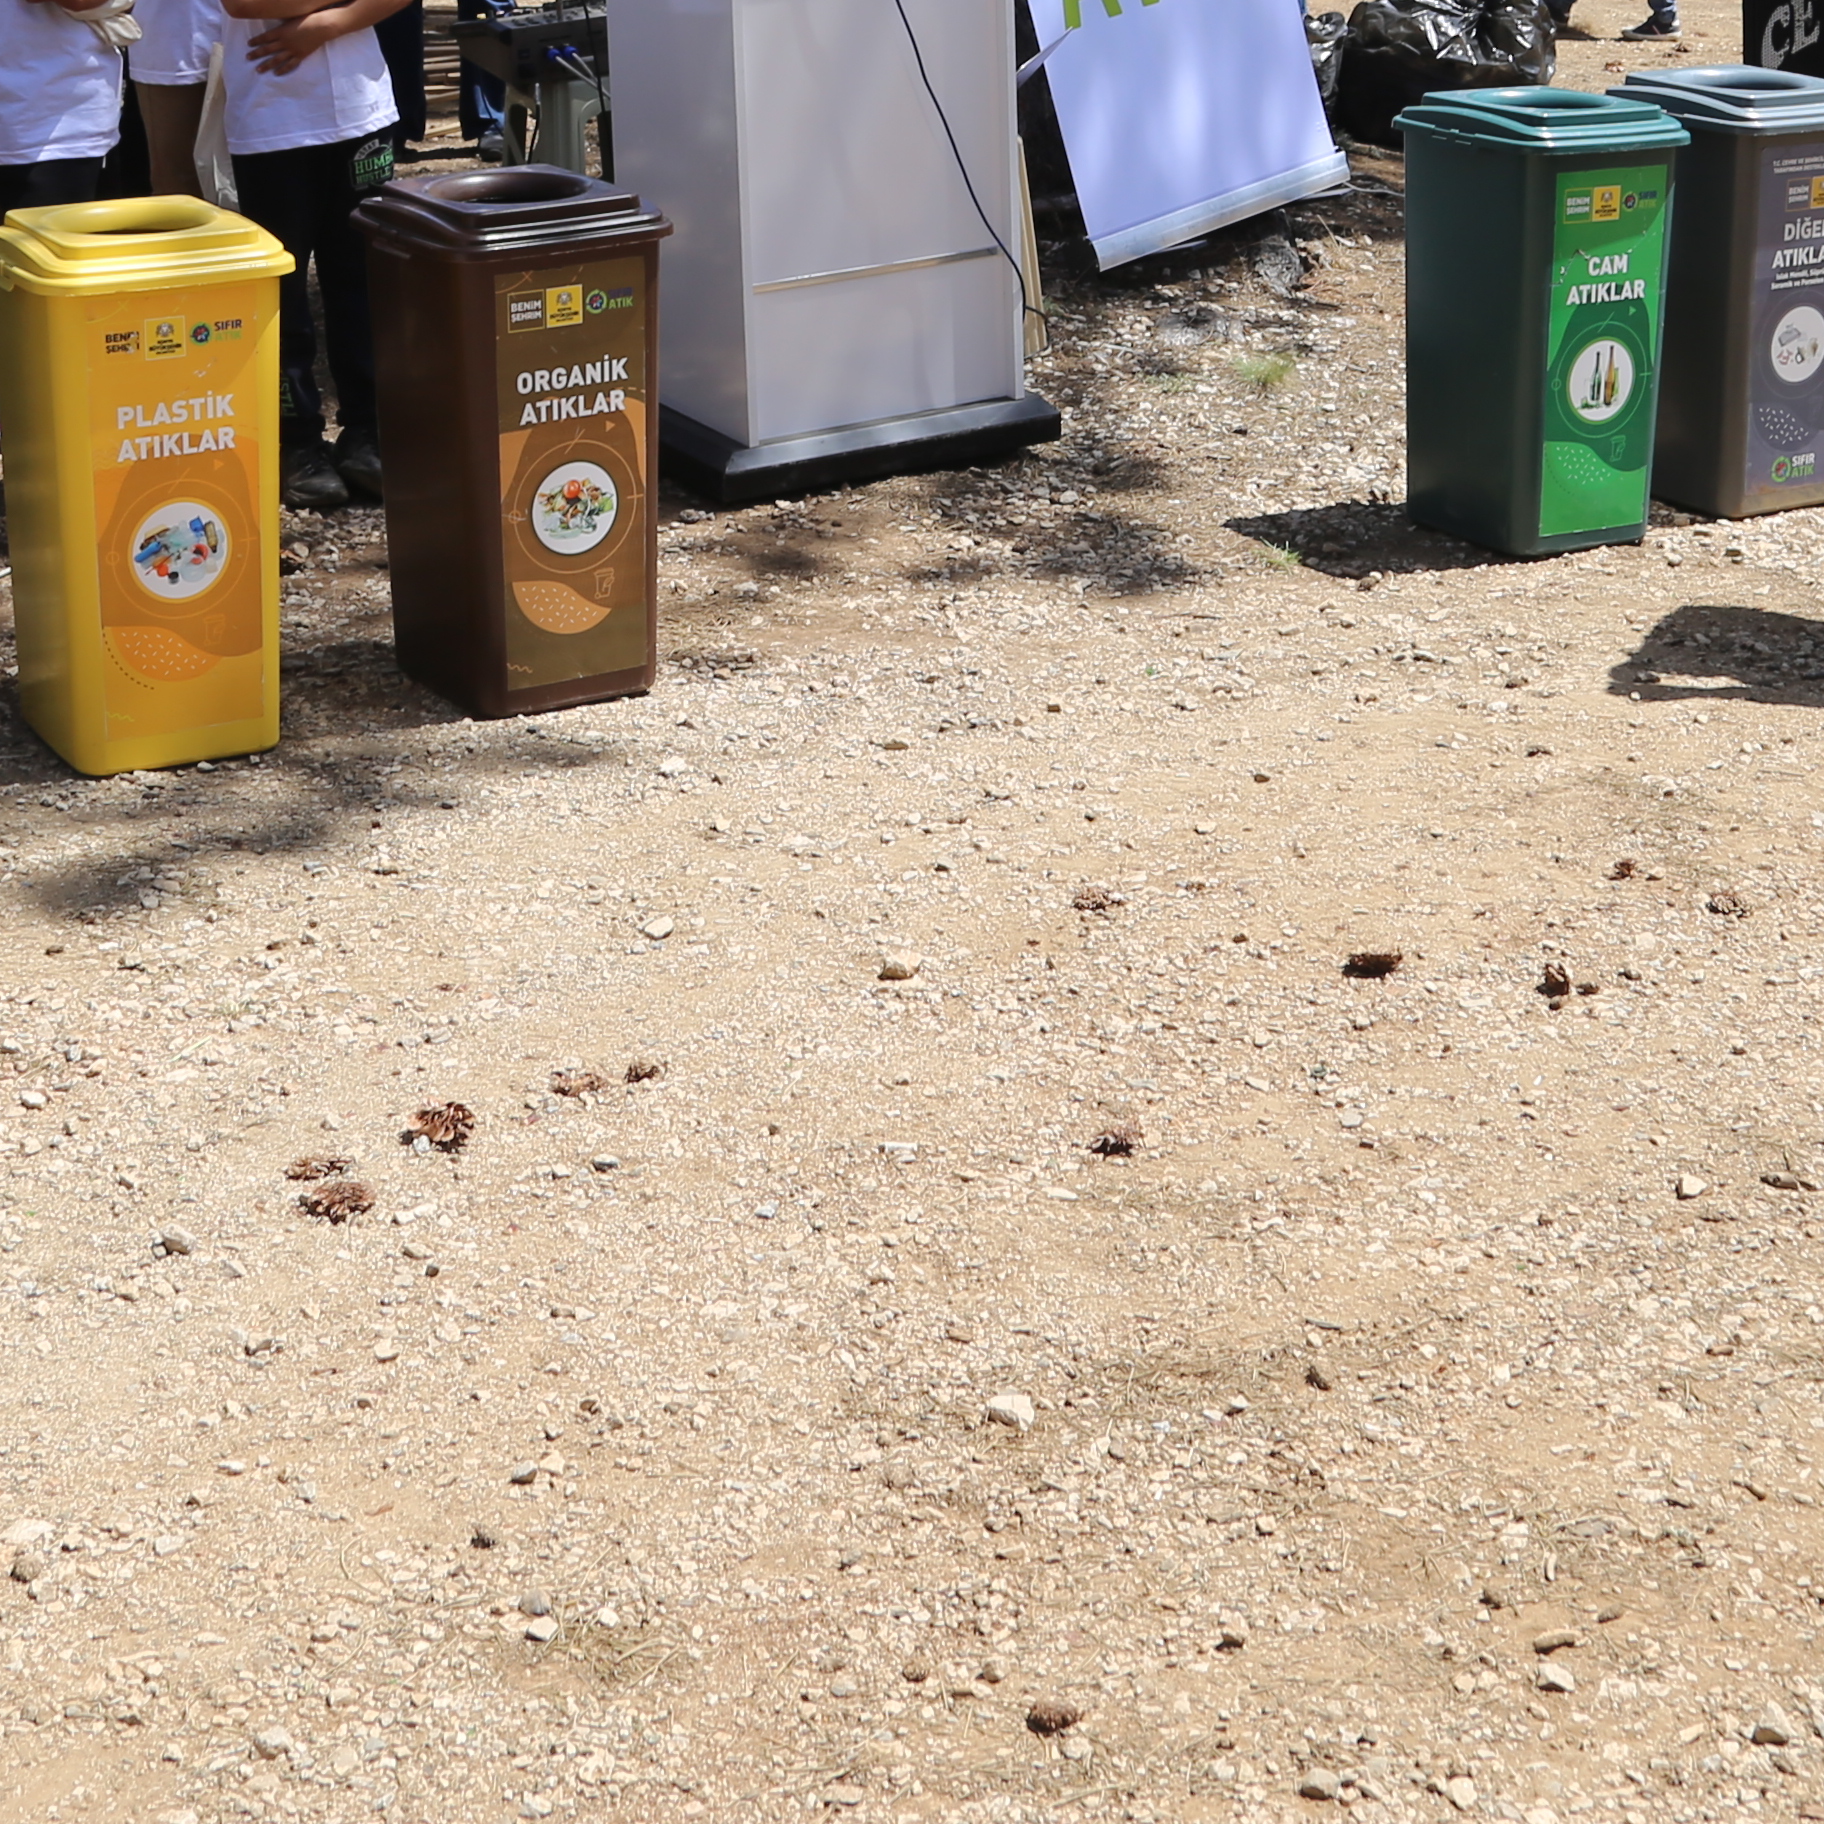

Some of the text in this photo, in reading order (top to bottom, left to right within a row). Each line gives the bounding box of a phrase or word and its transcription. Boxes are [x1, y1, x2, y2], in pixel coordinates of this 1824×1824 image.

[1588, 254, 1629, 276] CAM
[608, 296, 633, 310] ATIK
[1566, 279, 1645, 305] ATIKLAR
[214, 319, 242, 331] SIFIR
[516, 354, 629, 395] ORGANİK
[117, 390, 235, 430] PLASTİK
[519, 389, 626, 426] ATIKLAR
[117, 426, 236, 463] ATIKLAR
[1791, 452, 1815, 467] SIFIR
[1791, 464, 1814, 478] ATIK
